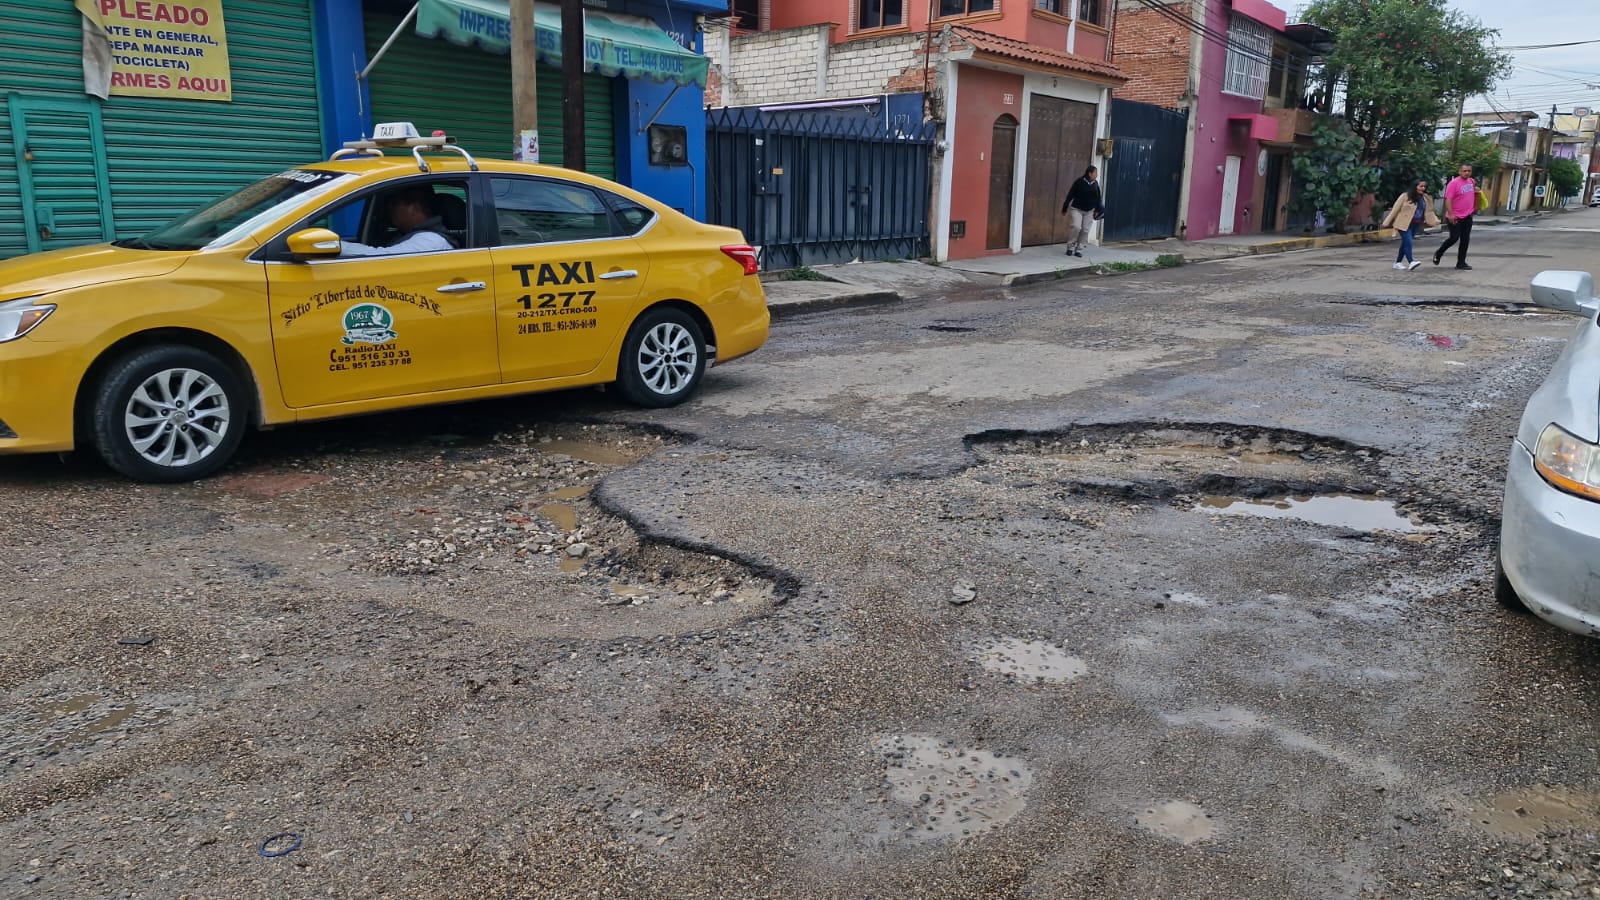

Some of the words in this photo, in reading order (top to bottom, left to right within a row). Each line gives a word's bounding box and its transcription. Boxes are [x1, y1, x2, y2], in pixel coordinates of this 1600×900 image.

[100, 0, 209, 26] PLEADO
[135, 28, 152, 38] EN
[156, 30, 219, 46] GENERAL,
[109, 41, 139, 52] SEPA
[143, 43, 204, 57] MANEJAR
[111, 71, 171, 91] RMES
[177, 76, 227, 93] AQUI
[380, 126, 395, 137] TAXI
[511, 261, 596, 288] TAXI
[281, 302, 311, 327] Sitio
[364, 285, 376, 298] de
[517, 291, 596, 310] 1277
[351, 311, 369, 320] 1967
[329, 363, 350, 372] CEL.
[371, 360, 386, 368] 235
[338, 355, 356, 363] 951
[361, 353, 379, 361] 516
[383, 351, 395, 359] 30
